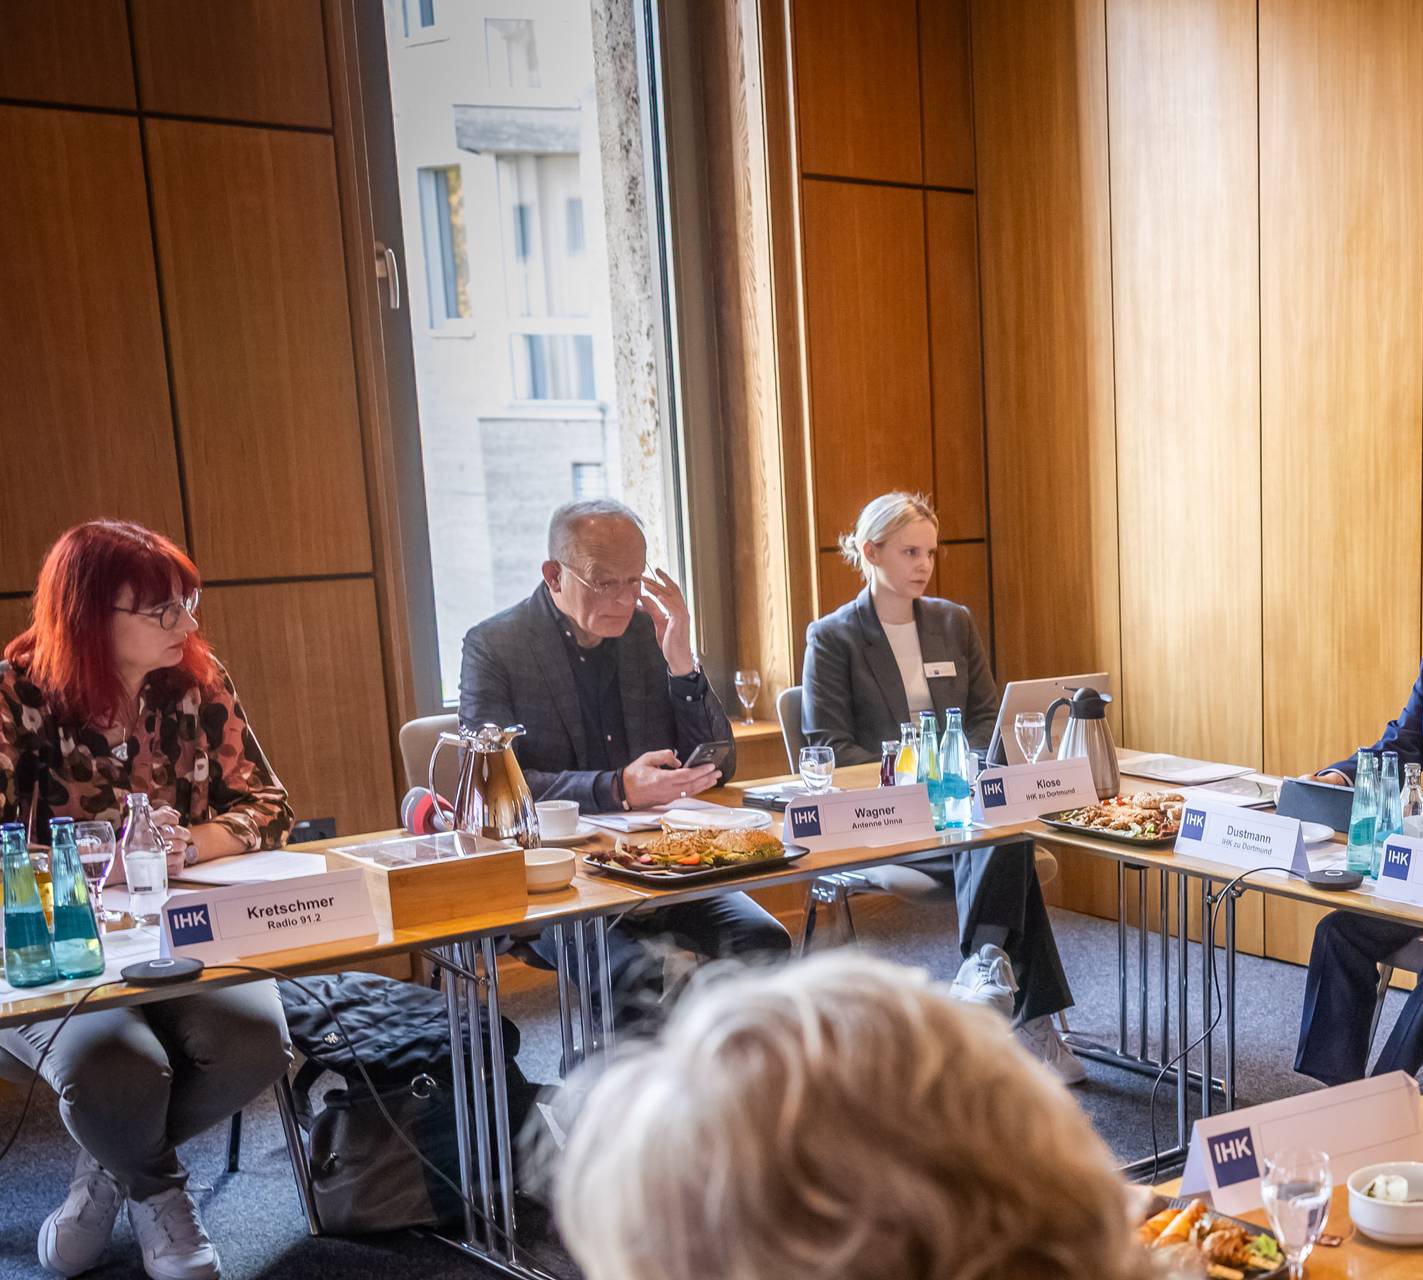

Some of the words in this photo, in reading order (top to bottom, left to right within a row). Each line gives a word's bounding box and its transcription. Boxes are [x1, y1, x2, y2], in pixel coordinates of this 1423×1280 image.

[983, 782, 1003, 796] IHK
[1036, 778, 1062, 789] Klose
[1046, 787, 1076, 798] Dortmund
[794, 810, 817, 825] IHK
[854, 806, 896, 819] Wagner
[1186, 812, 1204, 828] IHK
[852, 820, 883, 830] Antenne
[883, 818, 903, 826] Unna
[1226, 825, 1272, 844] Dustmann
[1221, 838, 1233, 847] IHK
[1242, 842, 1273, 856] Dortmund
[1388, 850, 1409, 866] IHK
[247, 896, 335, 920] Kretschmer
[173, 910, 207, 930] IHK
[267, 918, 298, 930] Radio
[299, 913, 322, 925] 91.2
[1214, 1136, 1252, 1164] IHK
